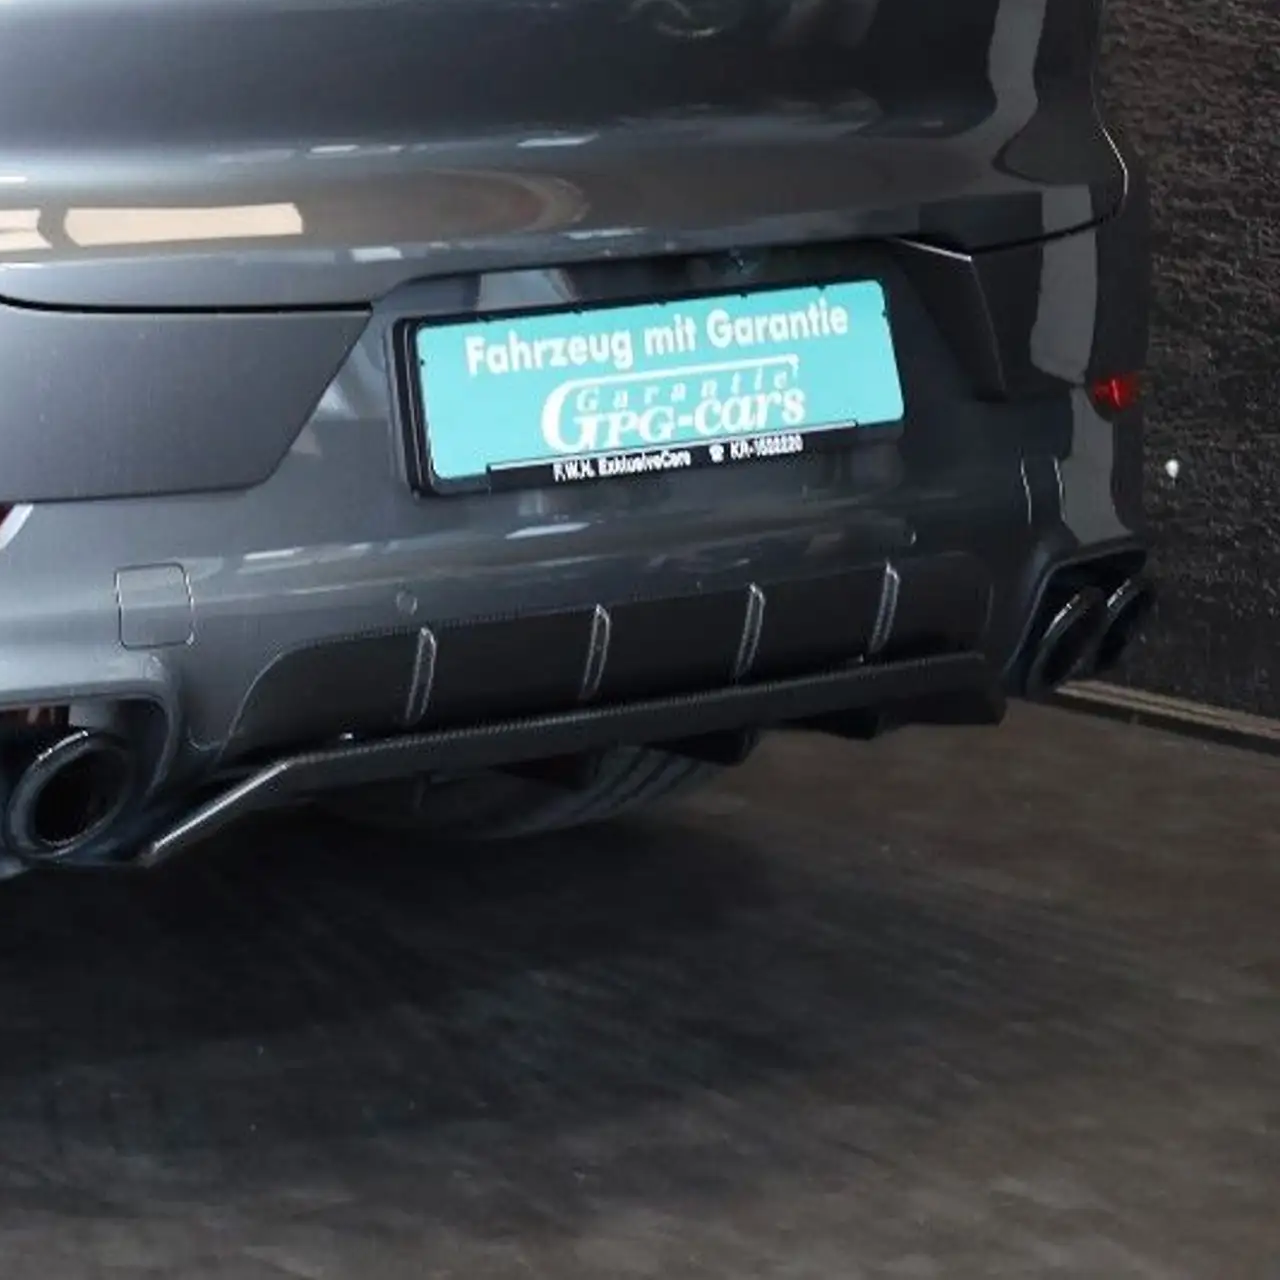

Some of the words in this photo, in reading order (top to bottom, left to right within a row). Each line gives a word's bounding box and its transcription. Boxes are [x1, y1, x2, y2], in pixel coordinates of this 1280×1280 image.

[464, 330, 634, 378] Fahrzeug
[644, 313, 697, 357] mit
[706, 298, 849, 348] Garantie
[542, 372, 806, 455] GPG-cars
[577, 365, 790, 413] Garantie
